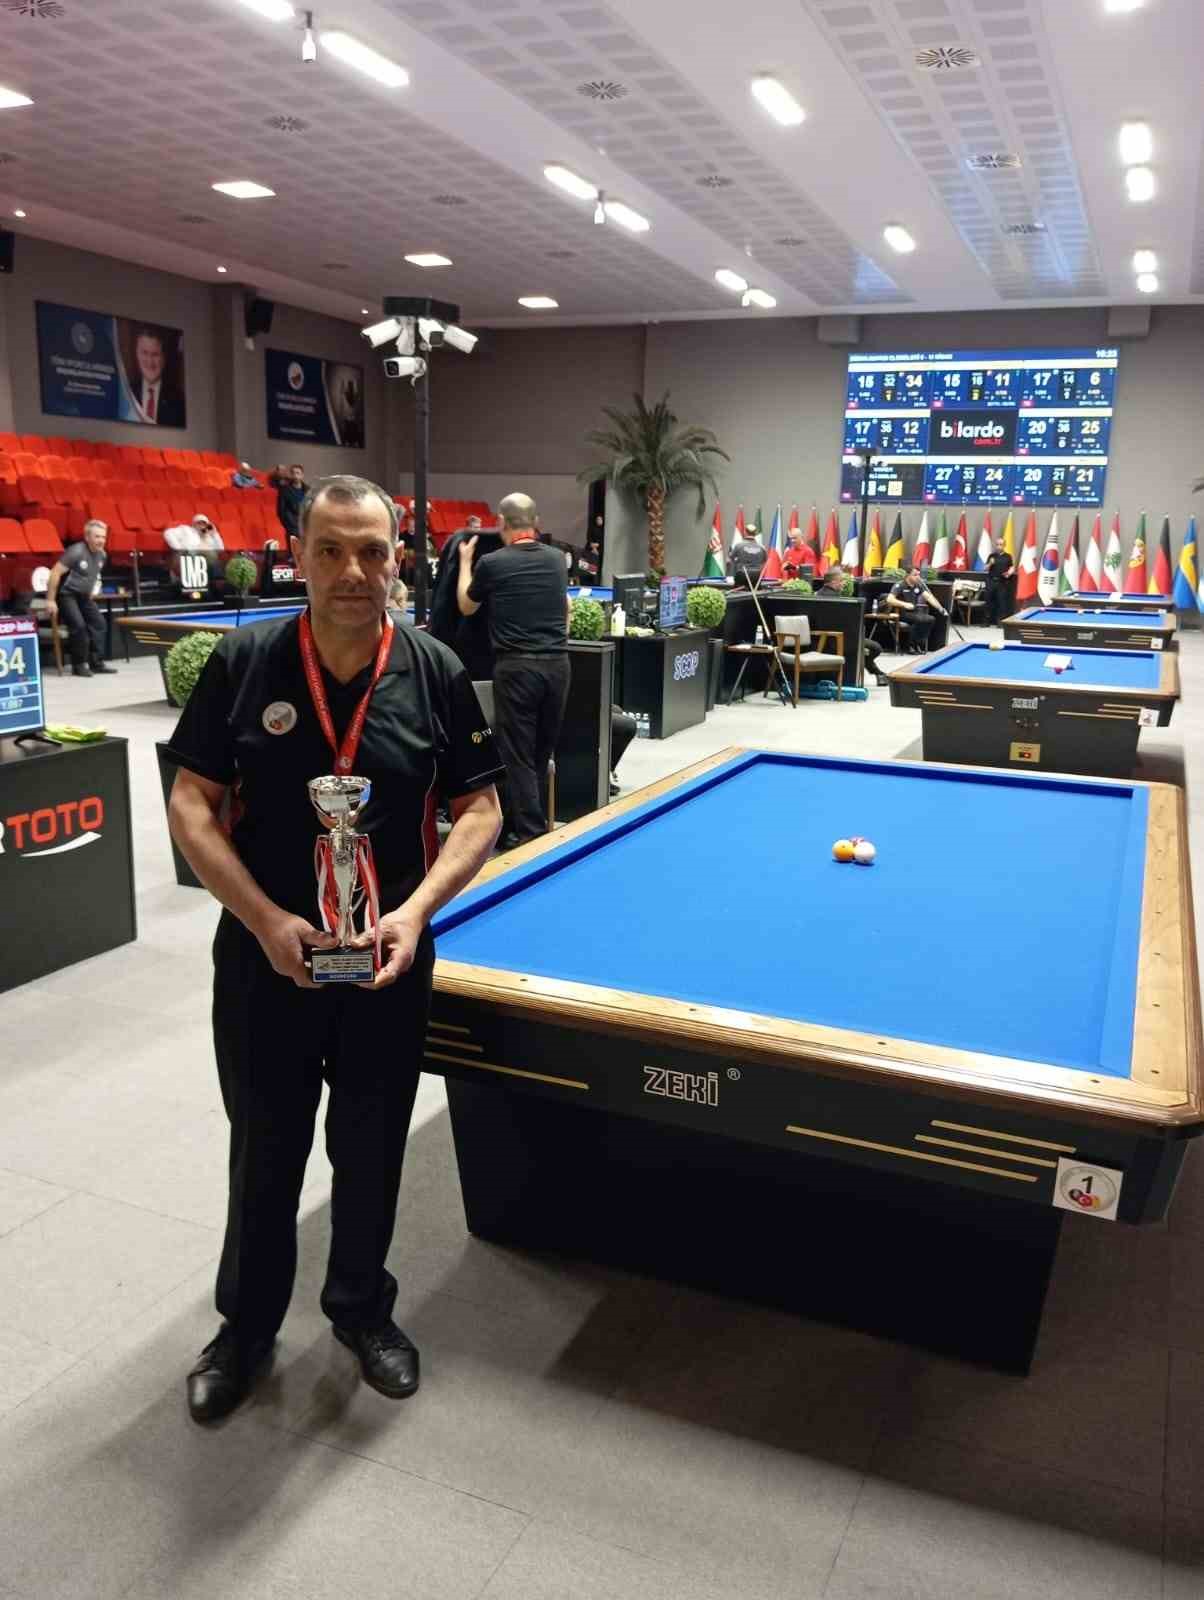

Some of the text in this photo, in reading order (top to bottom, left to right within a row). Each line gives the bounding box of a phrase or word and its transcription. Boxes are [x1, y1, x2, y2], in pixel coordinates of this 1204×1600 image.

[905, 374, 923, 388] 34
[994, 372, 1010, 387] 11
[1033, 372, 1052, 386] 17
[1090, 371, 1100, 386] 6
[854, 421, 871, 435] 17
[902, 421, 920, 435] 12
[940, 419, 1005, 438] bilardo
[1027, 420, 1047, 435] 20
[934, 467, 953, 481] 27
[984, 467, 1004, 481] 24
[1023, 468, 1043, 482] 20
[1075, 468, 1095, 483] 21
[0, 796, 104, 855] TOTO
[1081, 1175, 1093, 1194] 1
